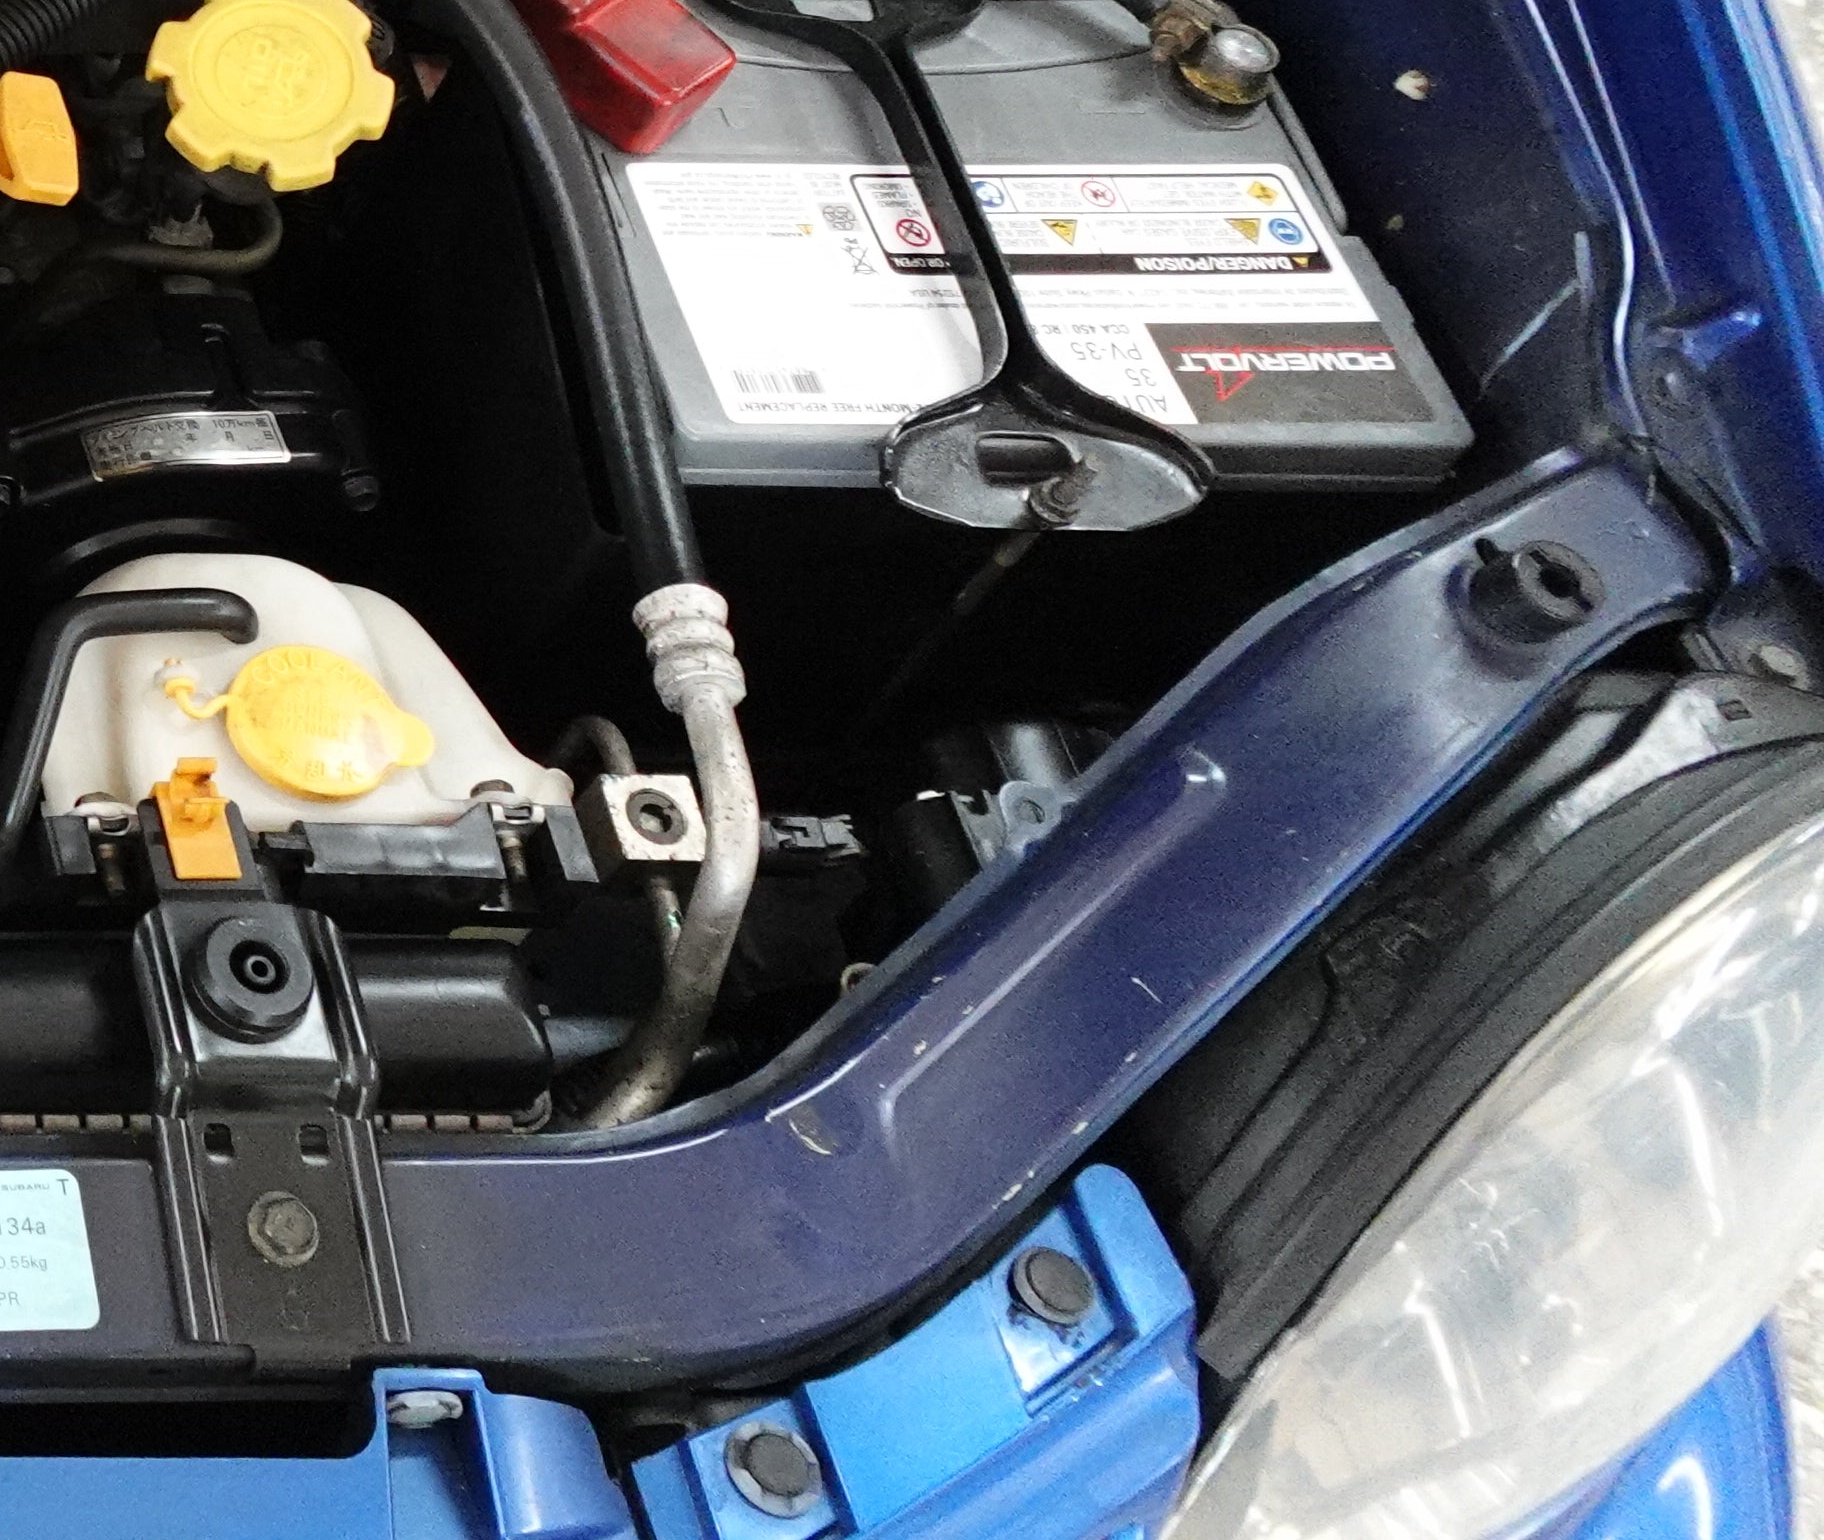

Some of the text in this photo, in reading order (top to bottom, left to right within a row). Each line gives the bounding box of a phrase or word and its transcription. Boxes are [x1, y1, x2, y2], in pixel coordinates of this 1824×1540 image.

[1134, 256, 1294, 271] DANGER/POISON
[1041, 324, 1062, 335] RC
[1072, 324, 1097, 335] 450
[1100, 324, 1130, 334] CCA
[1071, 342, 1143, 361] PV-35
[1174, 351, 1396, 372] POWERVOLT
[1125, 368, 1157, 387] 35
[737, 403, 828, 413] REPLACEMENT
[831, 403, 862, 413] FREE
[0, 1182, 51, 1192] SUBARU
[55, 1179, 70, 1196] T
